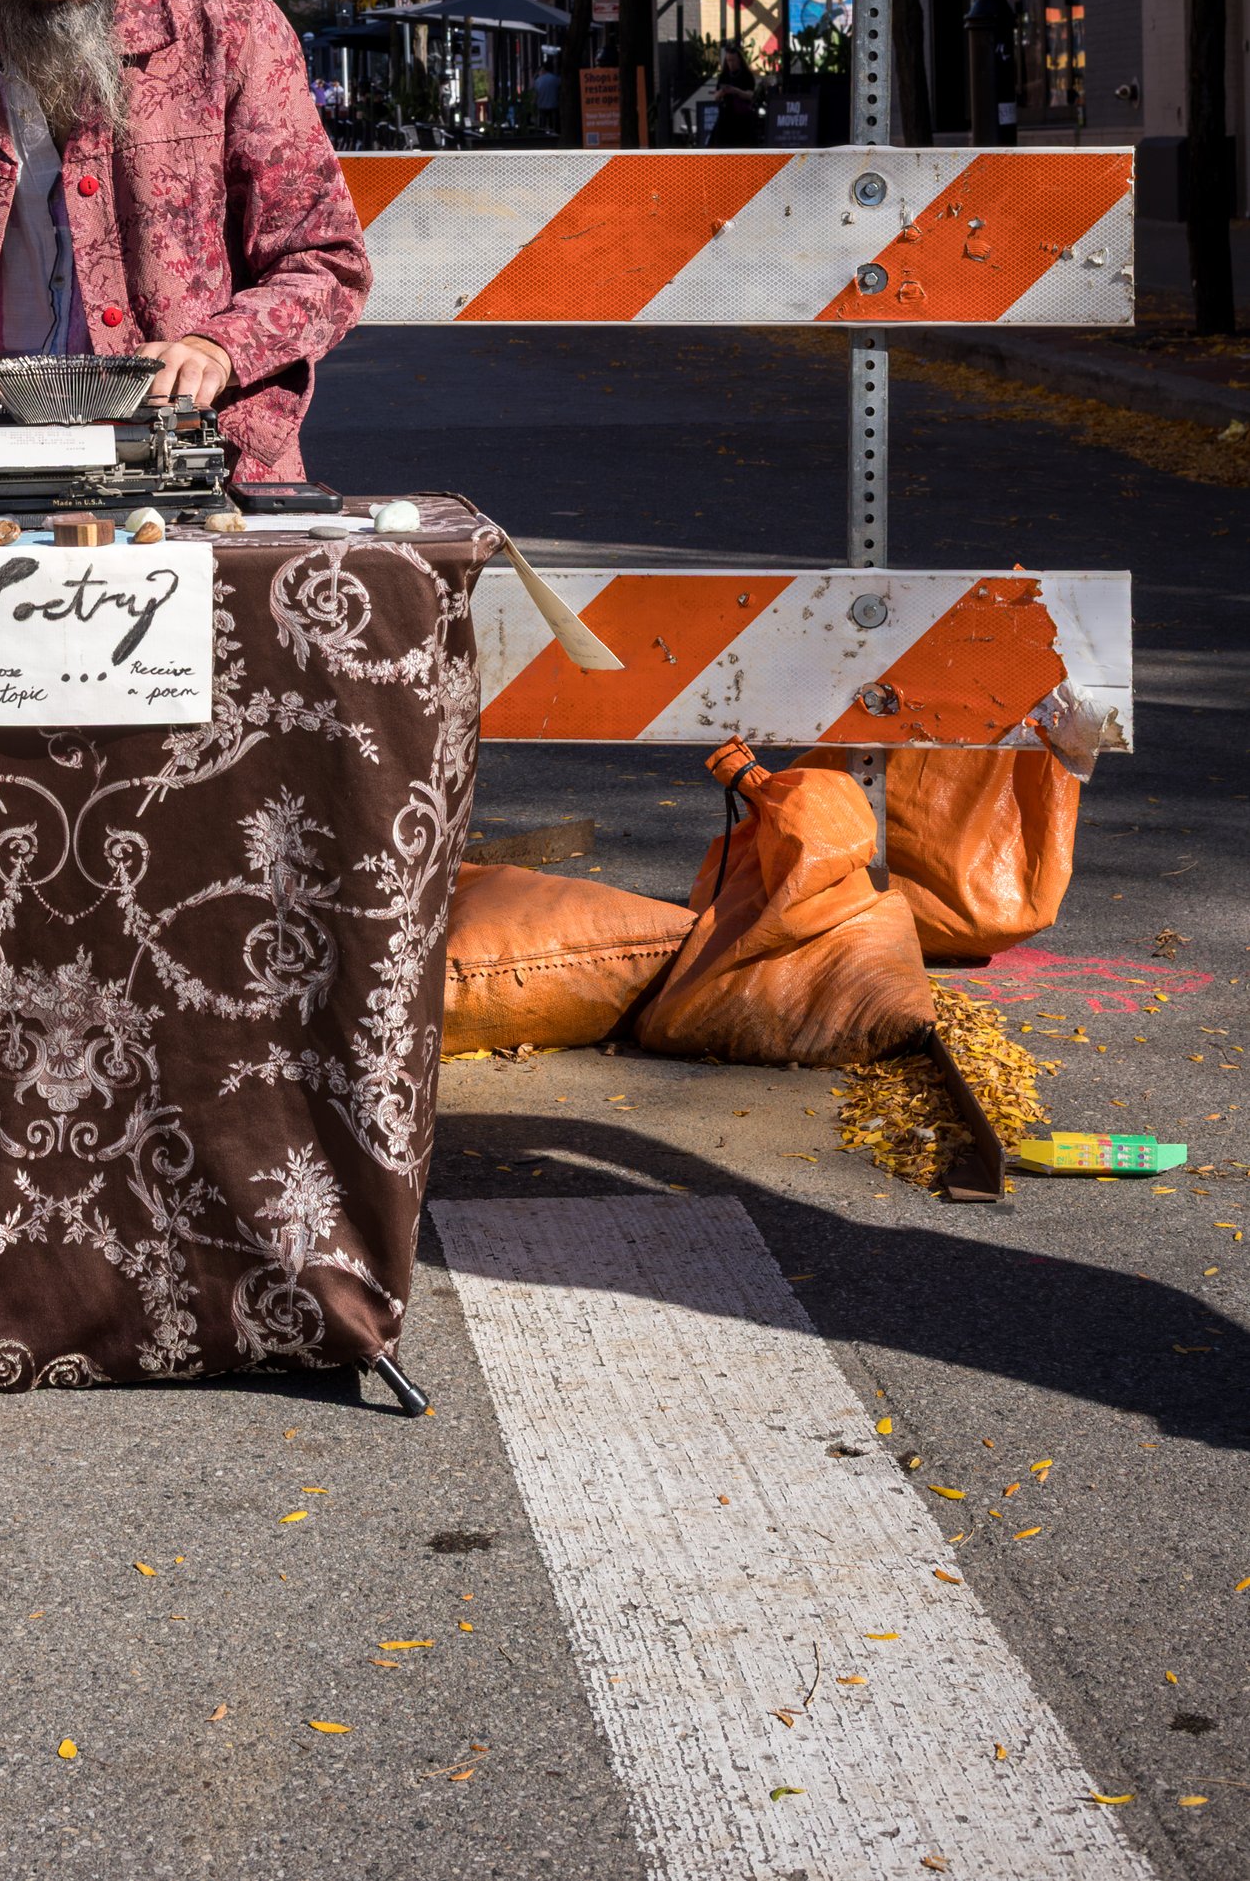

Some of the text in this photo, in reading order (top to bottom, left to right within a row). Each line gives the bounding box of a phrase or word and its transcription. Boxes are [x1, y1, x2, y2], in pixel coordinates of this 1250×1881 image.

[585, 85, 620, 95] restaur
[52, 499, 73, 507] Made
[84, 498, 106, 506] U.S.A.
[130, 660, 196, 677] Receive
[0, 683, 49, 709] topic
[128, 688, 139, 696] a
[146, 686, 200, 706] poem
